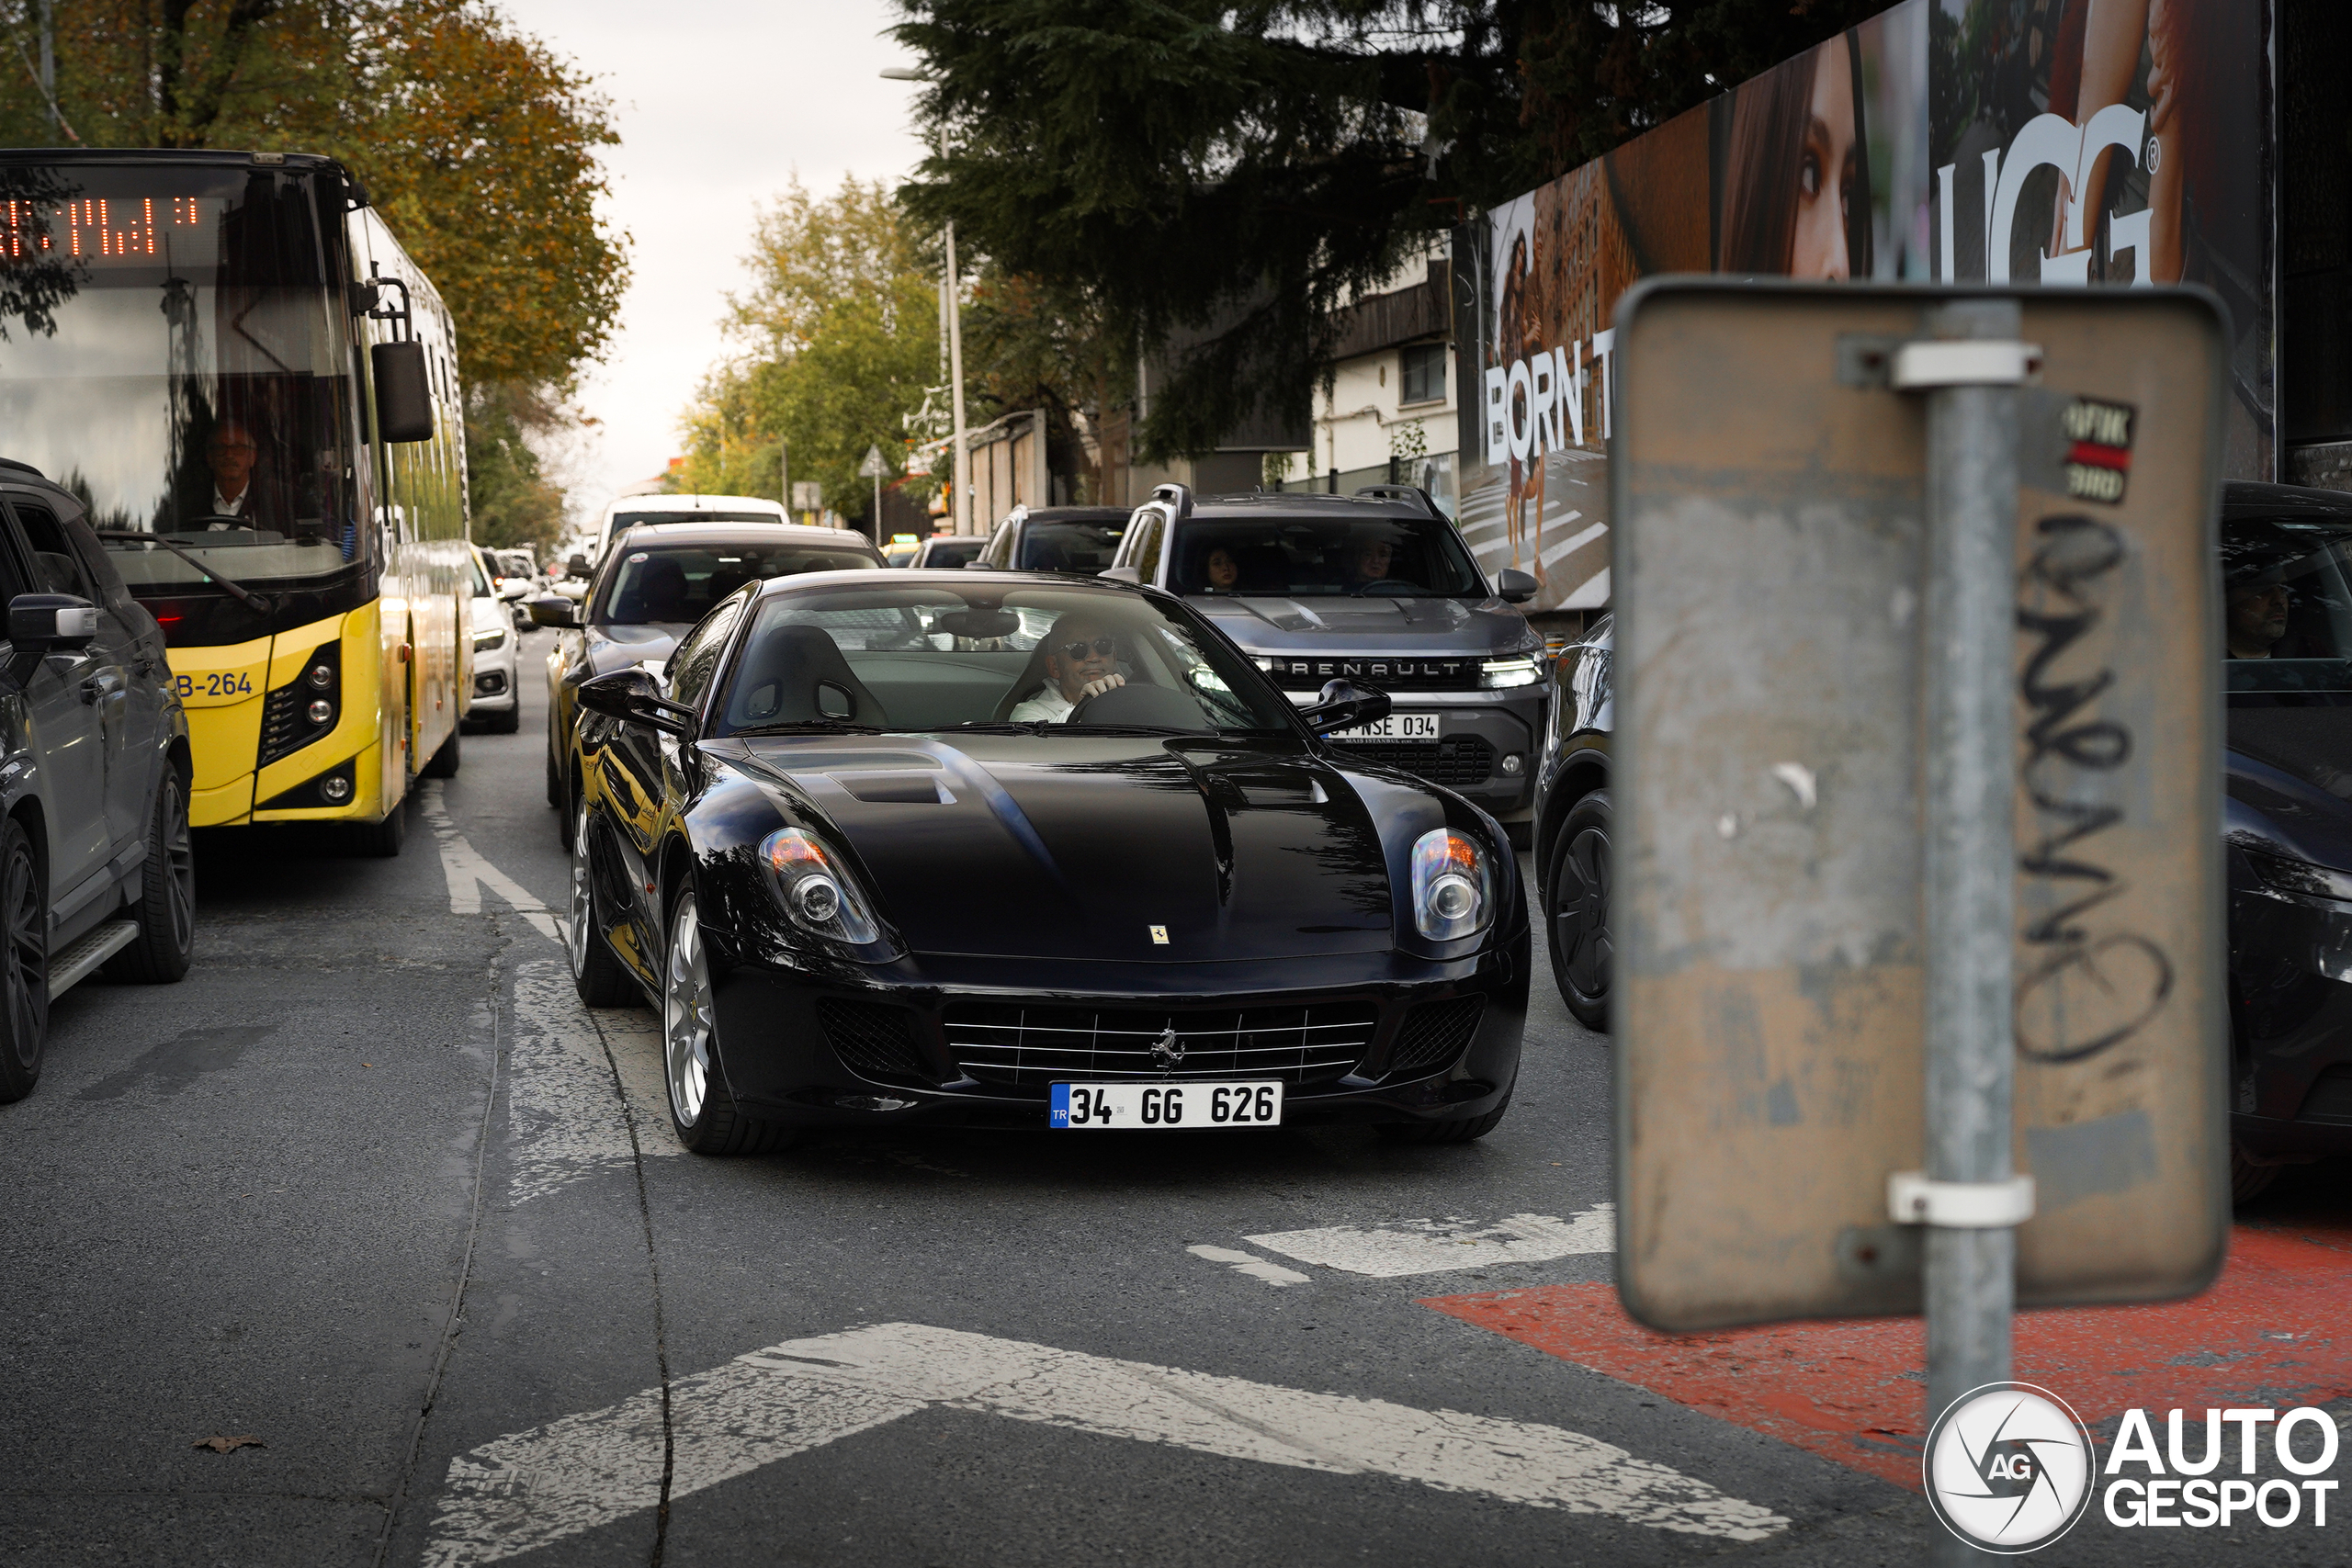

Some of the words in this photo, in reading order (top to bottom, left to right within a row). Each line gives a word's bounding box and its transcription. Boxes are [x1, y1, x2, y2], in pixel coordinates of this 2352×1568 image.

[1937, 104, 2154, 288] UGG
[1486, 340, 1584, 465] BORN
[1292, 662, 1461, 676] RENAULT
[175, 672, 252, 698] B-264
[1362, 716, 1393, 736] NSE
[1403, 716, 1435, 736] 034
[1053, 1109, 1068, 1120] TR
[1070, 1089, 1113, 1124] 34
[1141, 1089, 1183, 1124] GG
[1211, 1087, 1274, 1122] 626
